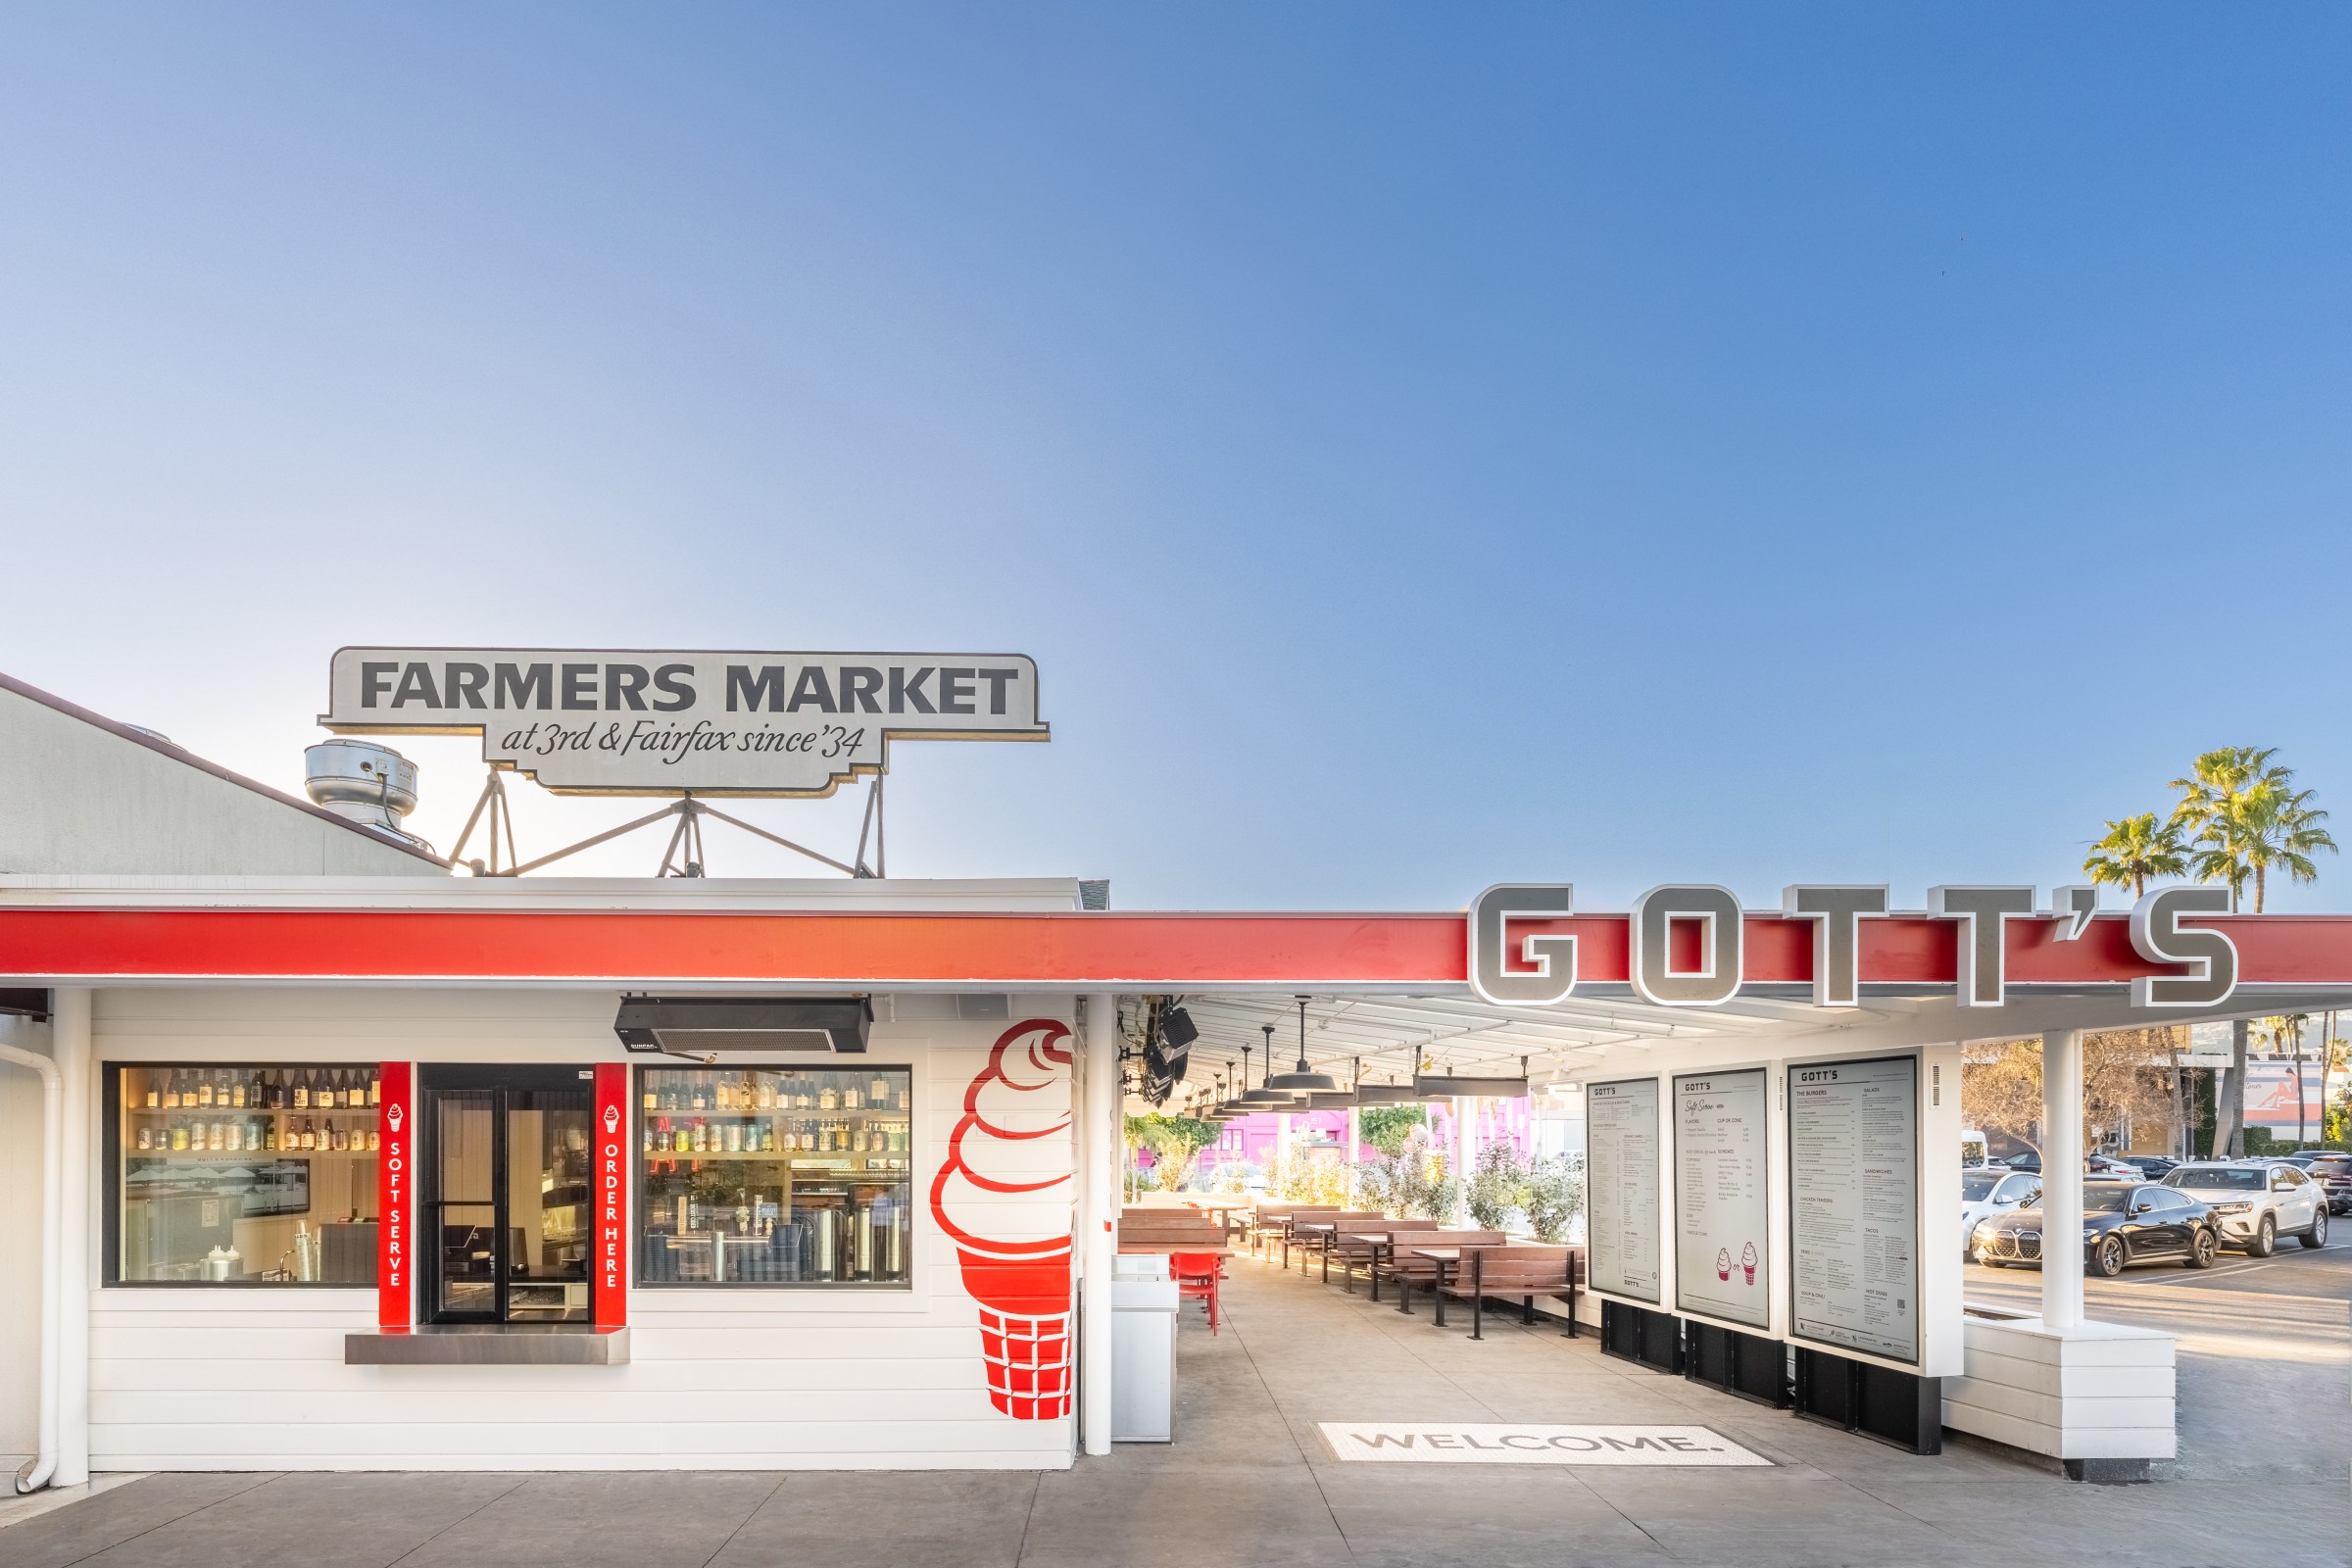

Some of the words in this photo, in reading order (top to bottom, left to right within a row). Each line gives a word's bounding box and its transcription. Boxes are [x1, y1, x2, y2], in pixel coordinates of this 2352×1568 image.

[362, 662, 697, 712] FARMERS
[726, 664, 1019, 715] MARKET
[501, 723, 539, 751] at
[536, 721, 598, 755] 3rd
[599, 721, 621, 751] &
[620, 719, 736, 764] Fairfax
[737, 722, 816, 753] since
[1467, 882, 2239, 1007] GOTT'S
[1594, 1087, 1616, 1097] GOTT'S
[1685, 1082, 1711, 1092] GOTT'S
[1801, 1070, 1838, 1082] GOTT'S
[388, 1142, 403, 1203] SOFT
[605, 1144, 618, 1221] ORDER
[389, 1209, 401, 1287] SERVE
[605, 1227, 617, 1288] HERE
[1349, 1433, 1727, 1453] WELCOME.
